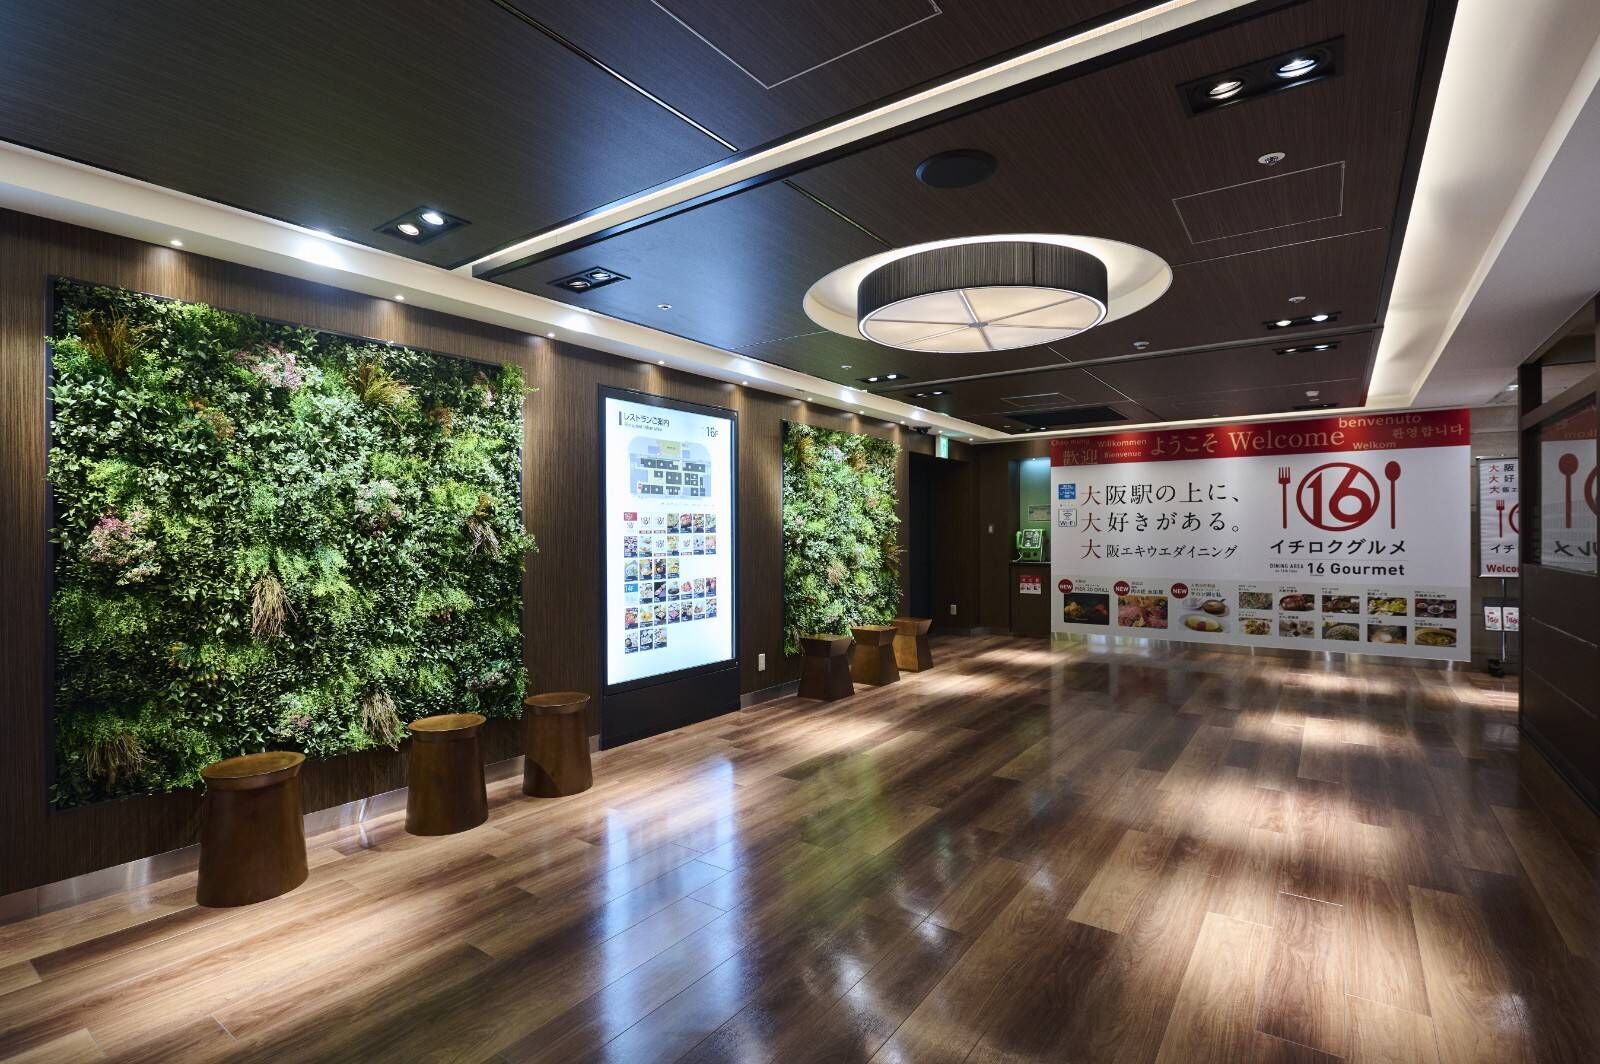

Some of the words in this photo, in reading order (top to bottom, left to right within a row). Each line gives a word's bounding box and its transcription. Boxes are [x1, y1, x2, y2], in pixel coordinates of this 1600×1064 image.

[1338, 414, 1422, 429] benvenuto
[1227, 427, 1345, 451] Welcome
[1391, 423, 1465, 440] 환영합니다
[1097, 438, 1147, 448] Willkommen
[1151, 433, 1219, 456] ようこそ
[1352, 440, 1397, 450] Welkom
[1104, 450, 1142, 458] Bienvenue
[1081, 511, 1239, 533] 大好きがある。
[1270, 538, 1406, 555] イチロクグルメ
[1307, 562, 1325, 574] 16
[1330, 562, 1405, 576] Gourmet
